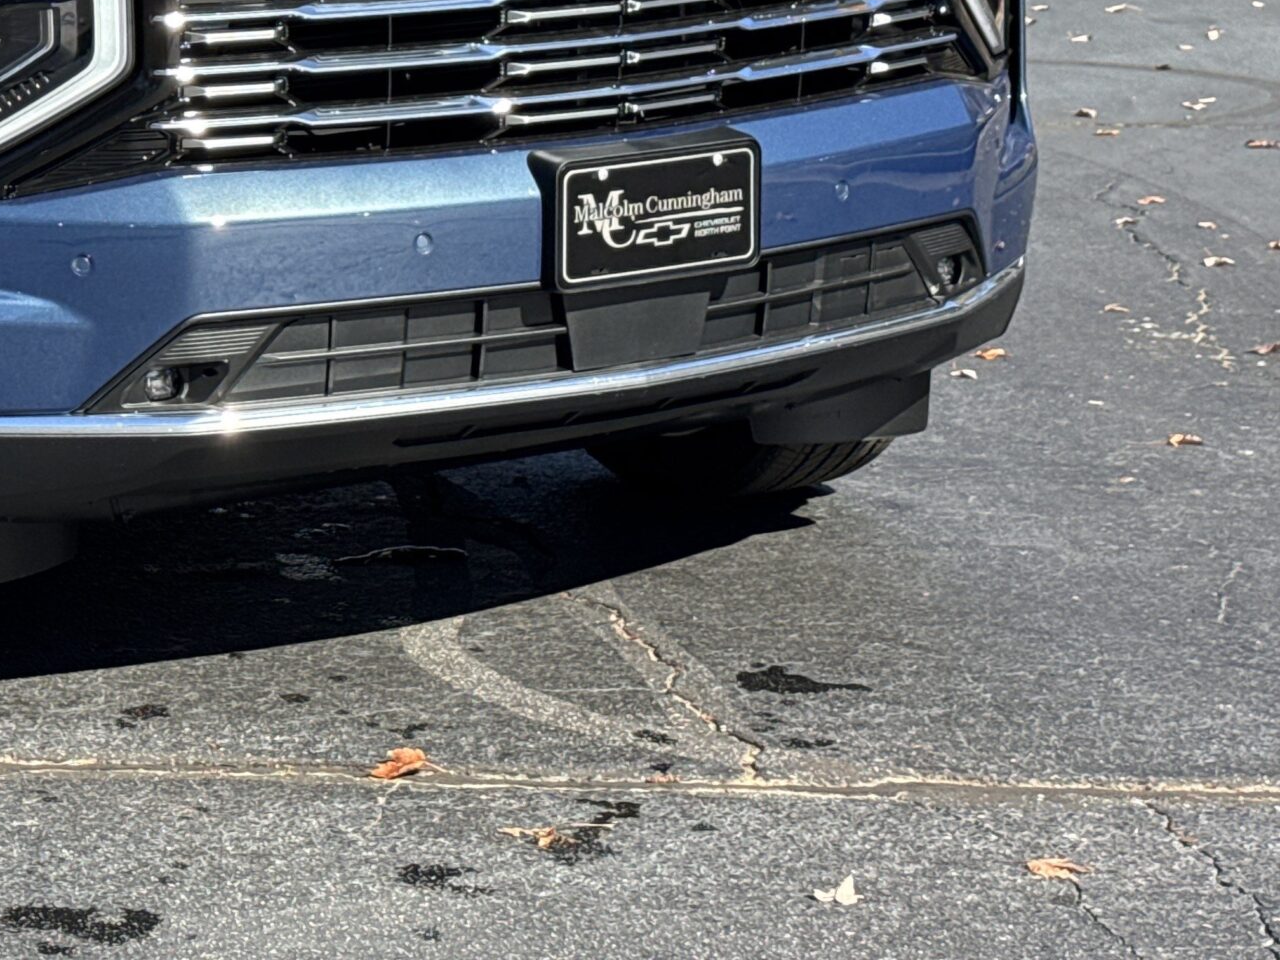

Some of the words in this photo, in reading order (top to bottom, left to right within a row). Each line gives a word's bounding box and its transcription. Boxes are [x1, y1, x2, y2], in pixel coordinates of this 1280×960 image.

[574, 199, 644, 223] Malcolm
[645, 187, 743, 213] Cunningham
[694, 215, 741, 228] CHEVROLET
[720, 223, 741, 234] POINT
